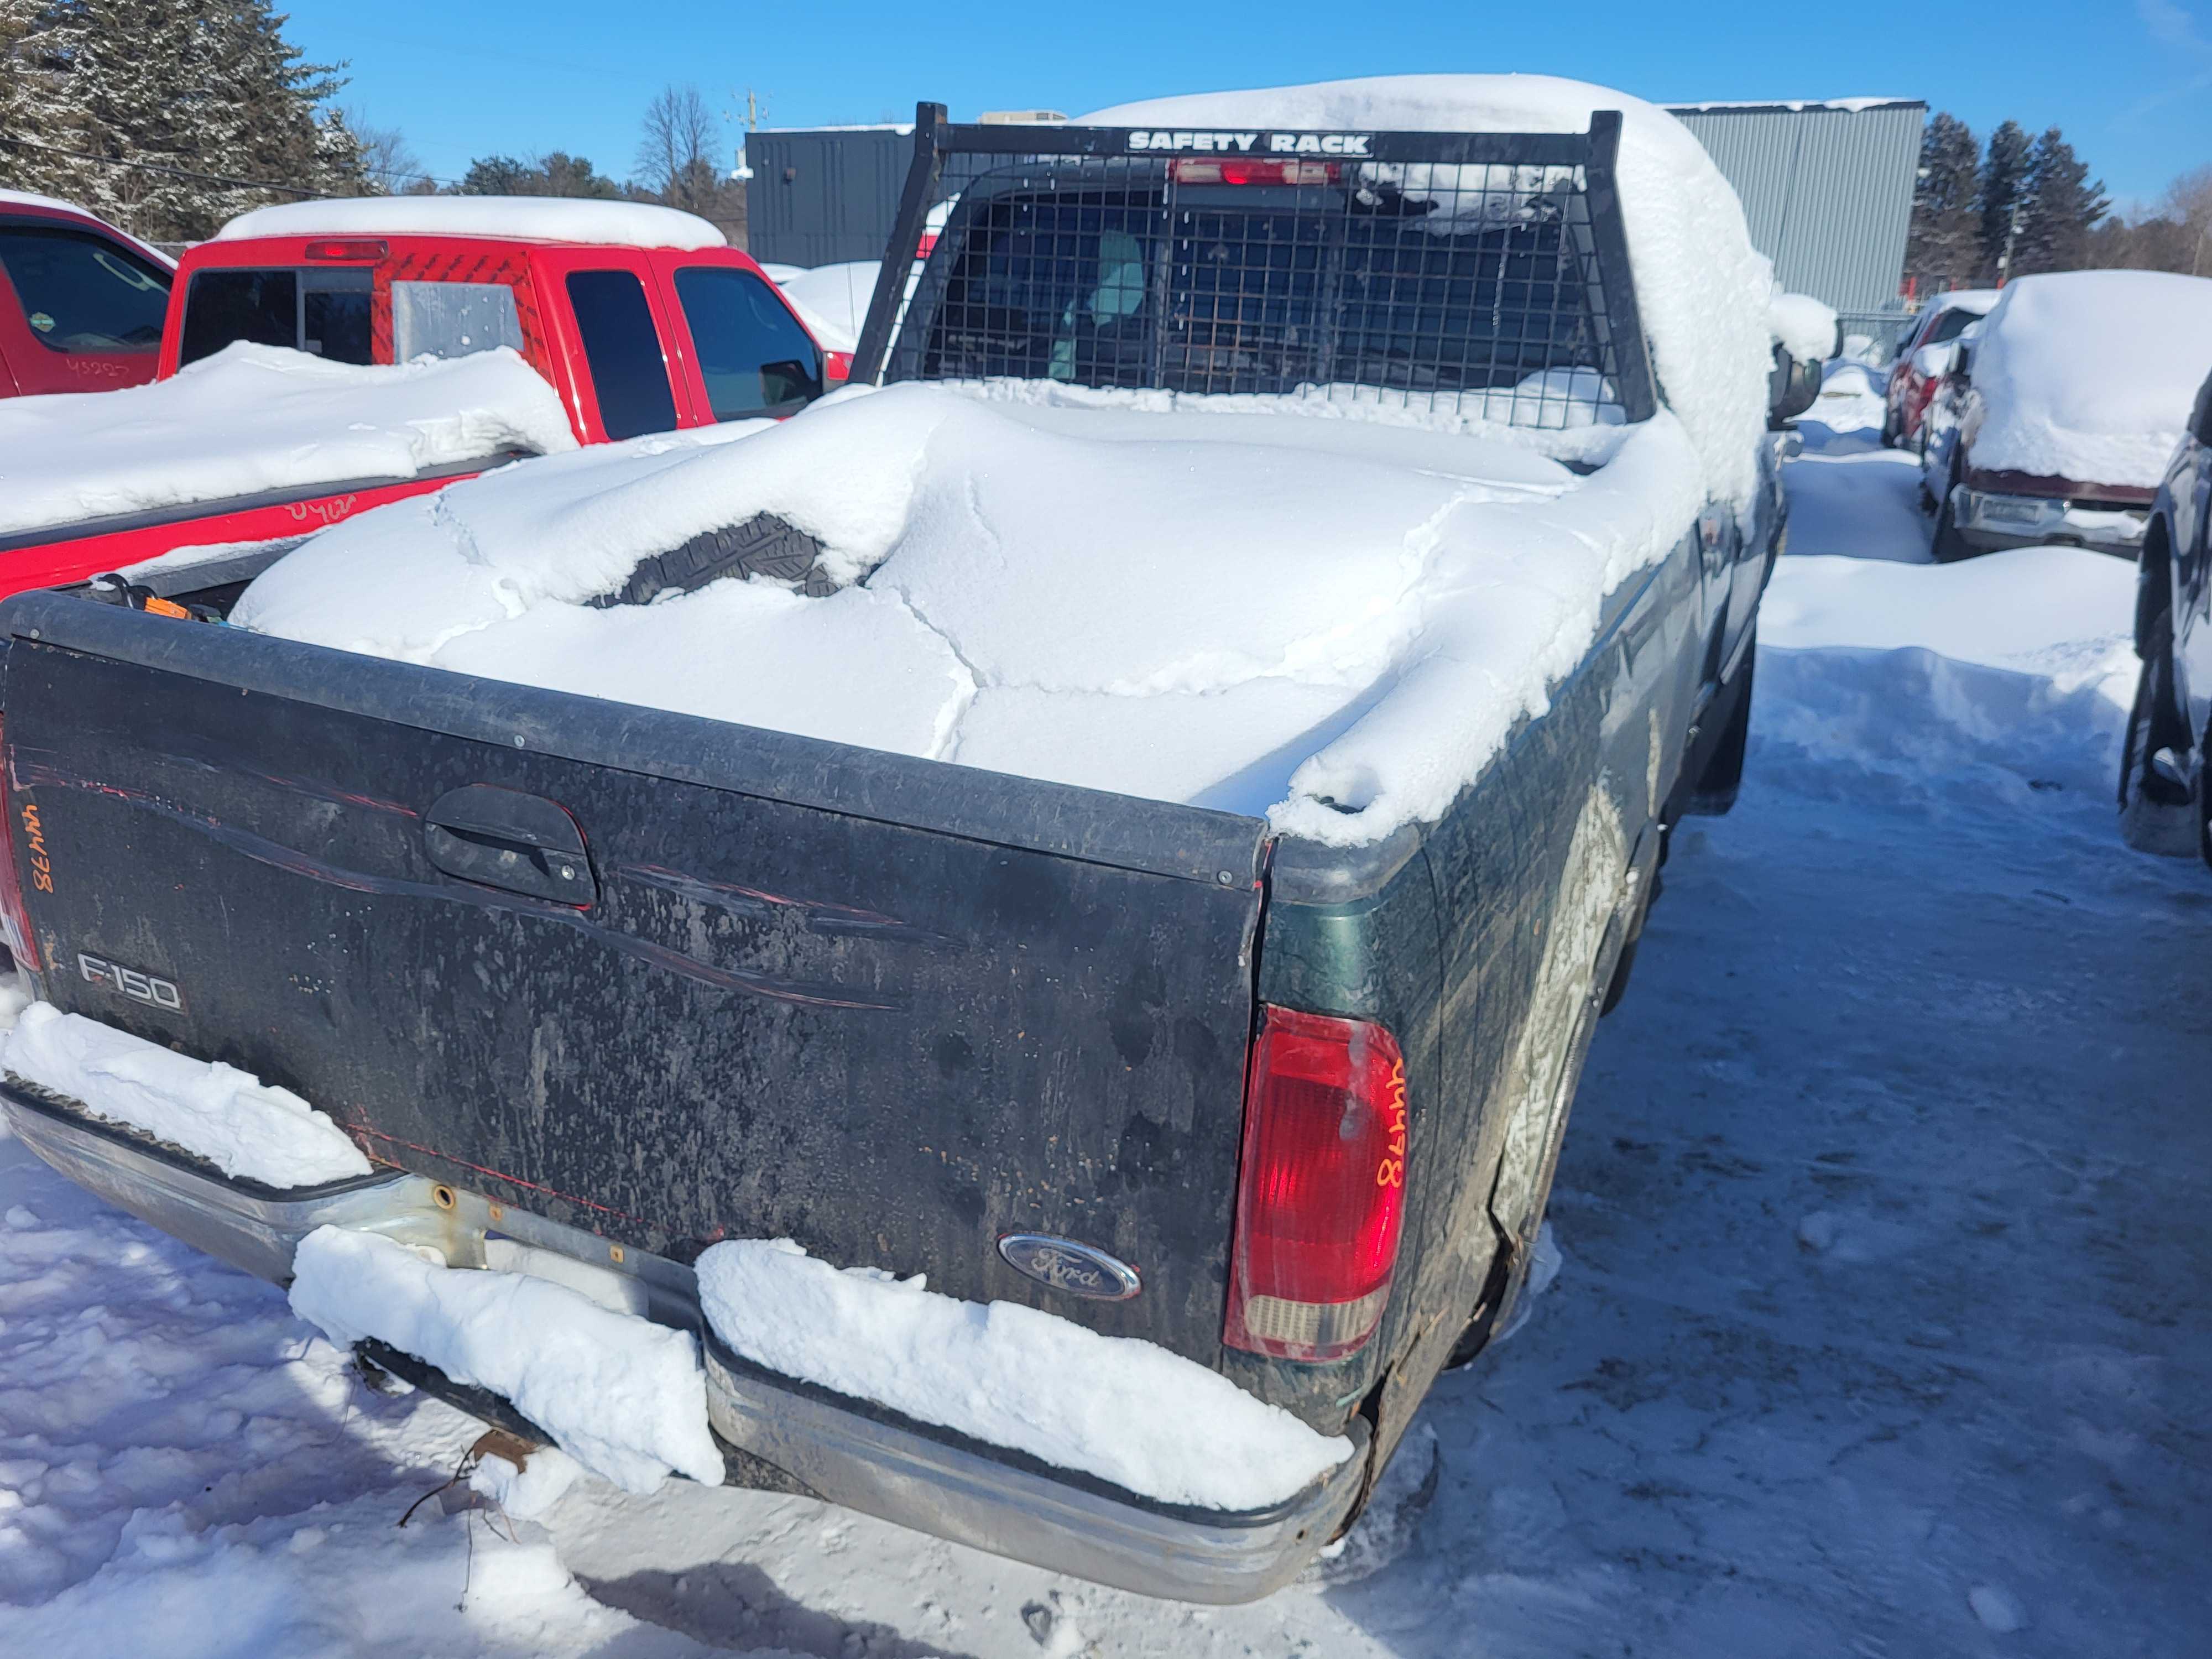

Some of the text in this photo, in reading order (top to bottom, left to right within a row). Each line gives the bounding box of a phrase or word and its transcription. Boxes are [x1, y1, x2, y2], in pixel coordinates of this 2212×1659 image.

[1128, 132, 1370, 154] SAFETY RACK
[22, 805, 54, 894] 44478
[77, 953, 181, 1009] F-150
[1377, 1057, 1406, 1187] 44478
[1031, 1248, 1100, 1290] Ford
